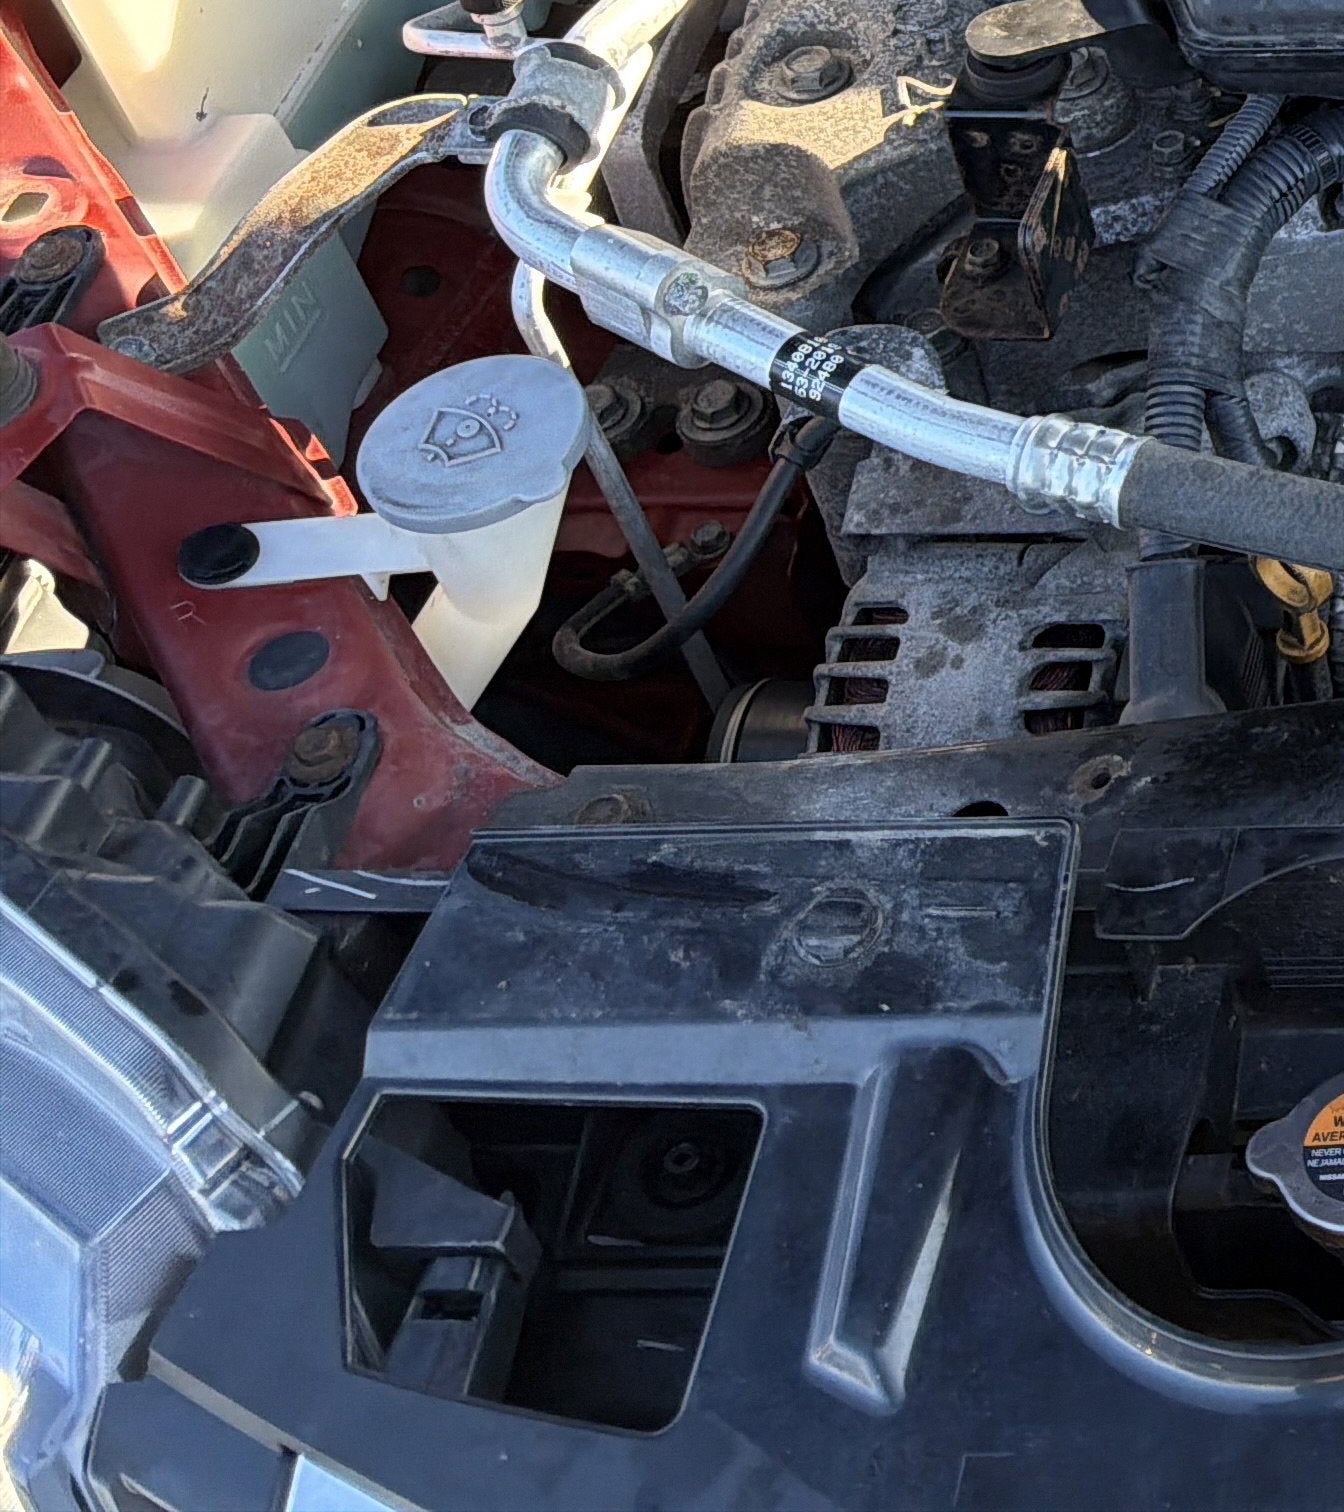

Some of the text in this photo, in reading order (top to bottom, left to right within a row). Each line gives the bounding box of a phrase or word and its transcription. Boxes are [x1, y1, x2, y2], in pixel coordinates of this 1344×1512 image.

[263, 280, 317, 361] MIN
[808, 354, 845, 402] 92480
[1307, 1159, 1319, 1168] NE
[1311, 1148, 1342, 1157] NEVER
